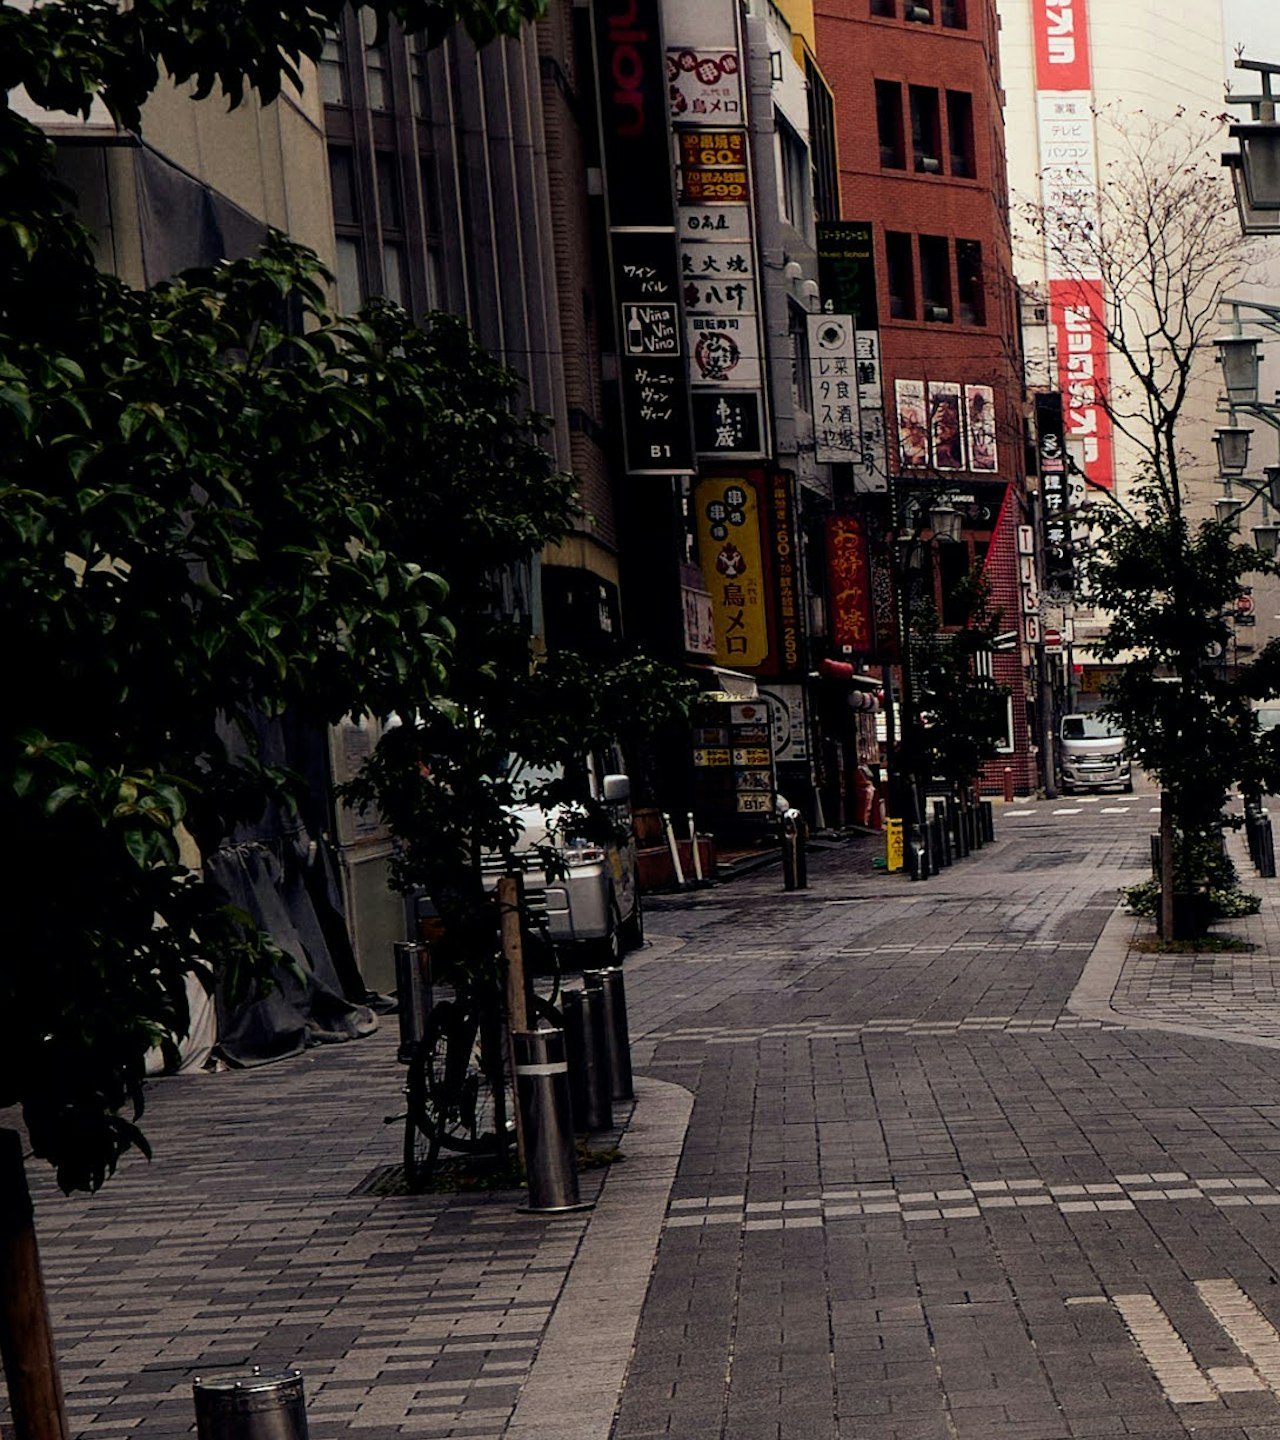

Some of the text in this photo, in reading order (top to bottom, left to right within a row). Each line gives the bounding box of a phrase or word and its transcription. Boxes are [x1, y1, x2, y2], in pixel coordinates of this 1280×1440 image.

[1052, 125, 1082, 137] テレビ
[1048, 147, 1088, 158] パソコン
[622, 264, 657, 278] ワイン
[641, 280, 669, 294] バル
[652, 322, 675, 338] Vin
[643, 336, 675, 352] Vino
[650, 444, 672, 459] B1
